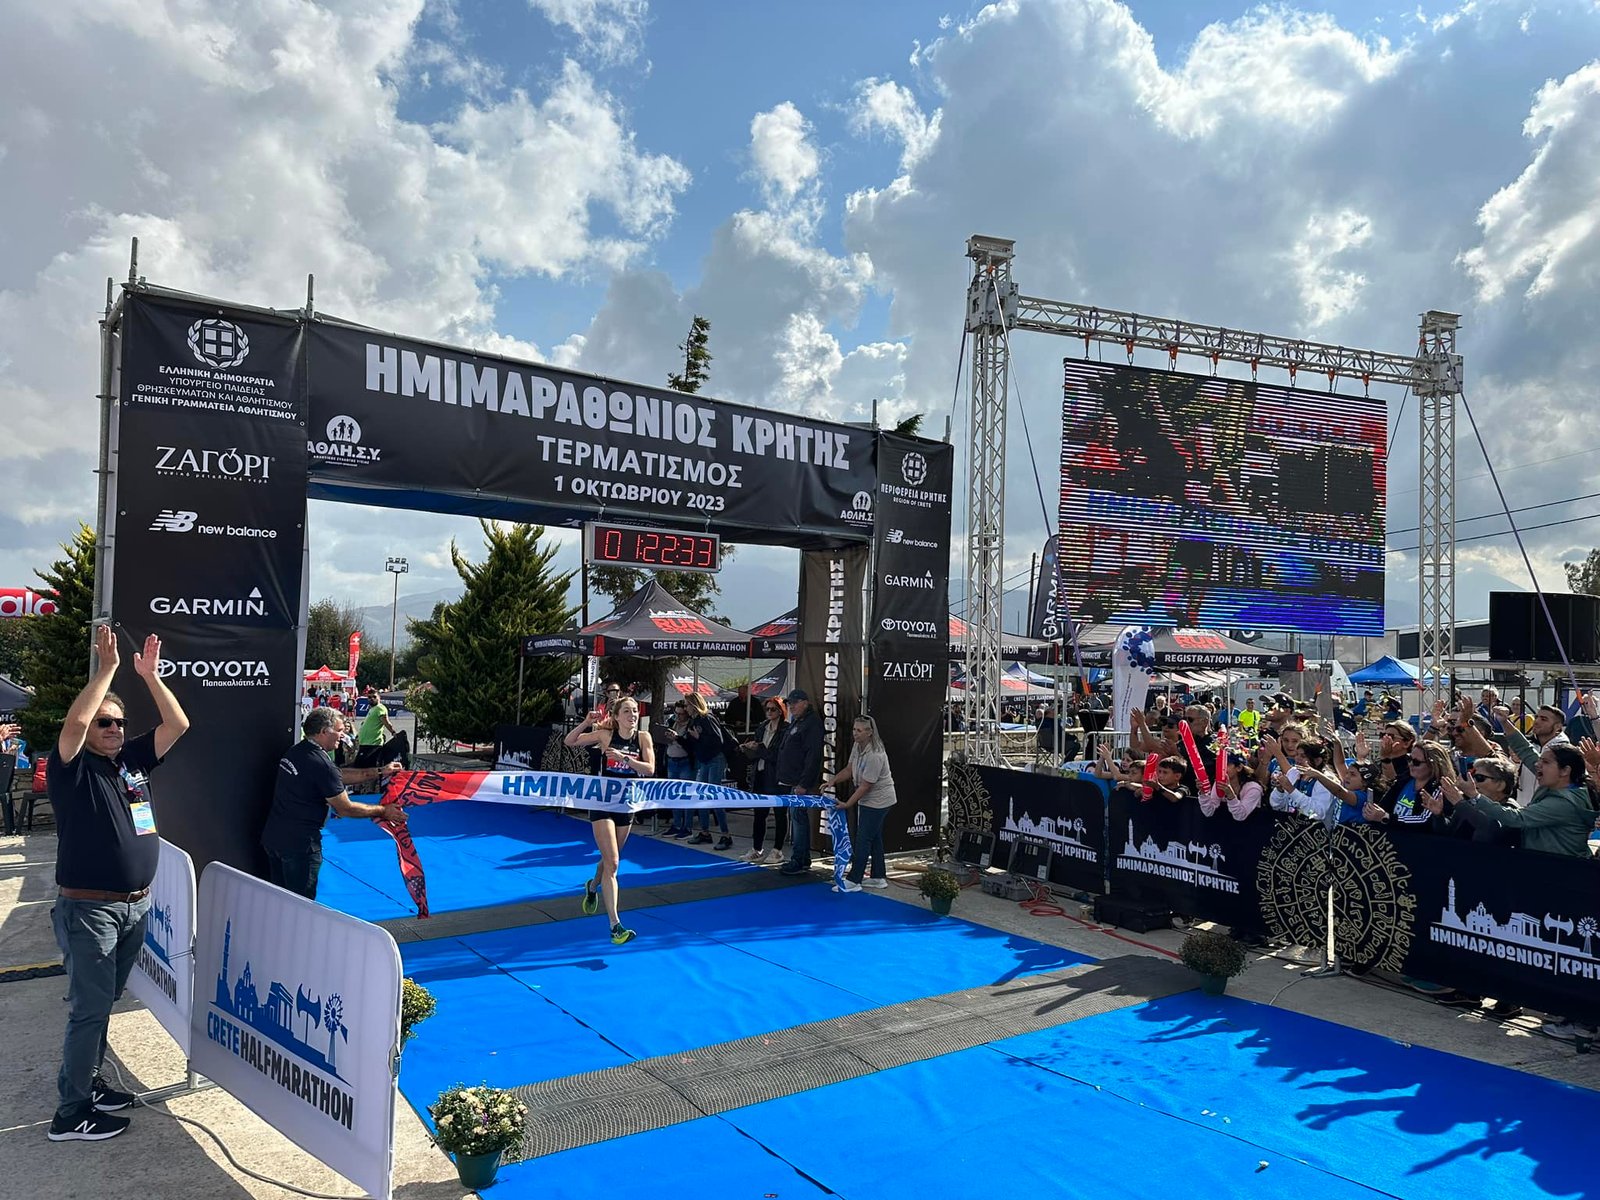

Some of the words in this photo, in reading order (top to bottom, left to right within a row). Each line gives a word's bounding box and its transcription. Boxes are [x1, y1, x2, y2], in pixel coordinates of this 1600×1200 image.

[159, 366, 211, 379] ΕΛΛΗΝΙΚΗ
[213, 372, 275, 388] ΔΗΜΟΚΡΑΤΙΑ
[169, 377, 222, 390] ΥΠΟΥΡΓΕΙΟ
[224, 384, 266, 396] ΠΑΙΔΕΙΑΣ
[137, 384, 216, 400] ΘΡΗΣΚΕΥΜΑΤΩΝ
[218, 393, 234, 402] ΚΑΙ
[235, 395, 293, 410] ΑΘΛΗΤΙΣΜΟΥ
[132, 394, 169, 406] ΓΕΝΙΚΗ
[172, 398, 235, 412] ΓΡΑΜΜΑΤΕΙΑ
[238, 406, 298, 420] ΑΘΛΗΤΙΣΜΟΥ
[366, 343, 717, 449] ΗΜΙΜΑΡΑΘΩΝΙΟΣ
[732, 414, 850, 471] ΚΡΗΤΗΣ
[536, 435, 743, 489] ΤΕΡΜΑΤΙΣΜΟΣ
[554, 476, 563, 492] 1
[571, 477, 682, 507] ΟΚΤΩΒΡΙΟΥ
[686, 492, 726, 512] 2023
[880, 483, 919, 500] ΠΕΡΙΦΕΡΕΙΑ
[920, 491, 947, 503] ΚΡΗΤΗΣ
[198, 524, 224, 536] new
[227, 526, 277, 538] balance
[915, 538, 938, 548] balance
[884, 574, 934, 590] GARMIN
[150, 597, 265, 616] GARMIN
[825, 559, 844, 643] ΚΡΗΤΗΣ
[895, 620, 936, 633] TOYOTA
[652, 641, 678, 649] CRETE
[680, 642, 701, 650] HALF
[702, 642, 747, 652] MARATHON
[174, 660, 270, 678] TOYOTA
[1164, 654, 1232, 664] REGISTRATION
[1234, 656, 1260, 665] DESK
[1064, 845, 1098, 862] ΚΡΗΤΗΣ
[1116, 857, 1195, 884] ΗΜΙΜΑΡΑΘΩΝΙΟΣ
[1198, 874, 1240, 894] ΚΡΗΤΗΣ
[1430, 926, 1553, 970] ΗΜΙΜΑΡΑΘΩΝΙΟΣ
